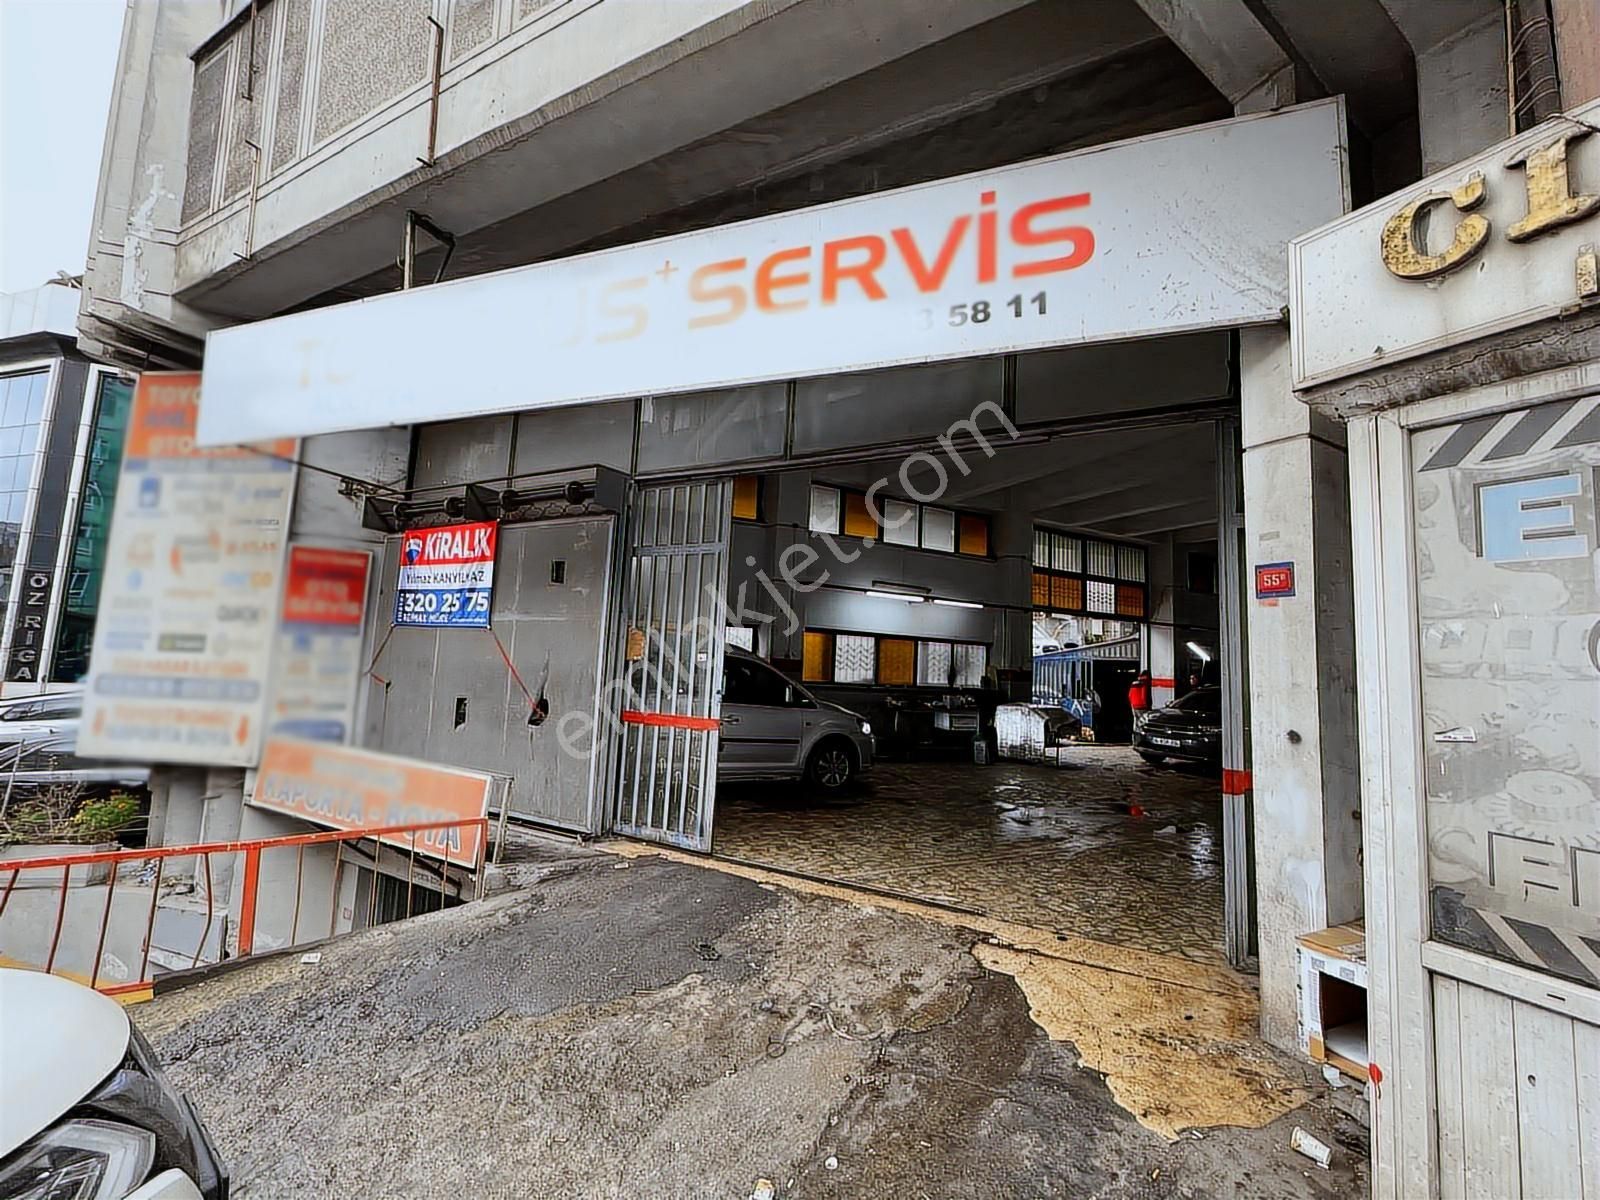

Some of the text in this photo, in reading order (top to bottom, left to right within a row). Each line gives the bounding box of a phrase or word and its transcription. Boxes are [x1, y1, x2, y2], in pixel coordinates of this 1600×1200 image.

[688, 190, 1096, 330] SERVİS
[948, 300, 991, 328] 58
[1006, 291, 1048, 319] 11
[404, 593, 437, 612] 320
[440, 593, 462, 612] 25
[465, 592, 489, 611] 75
